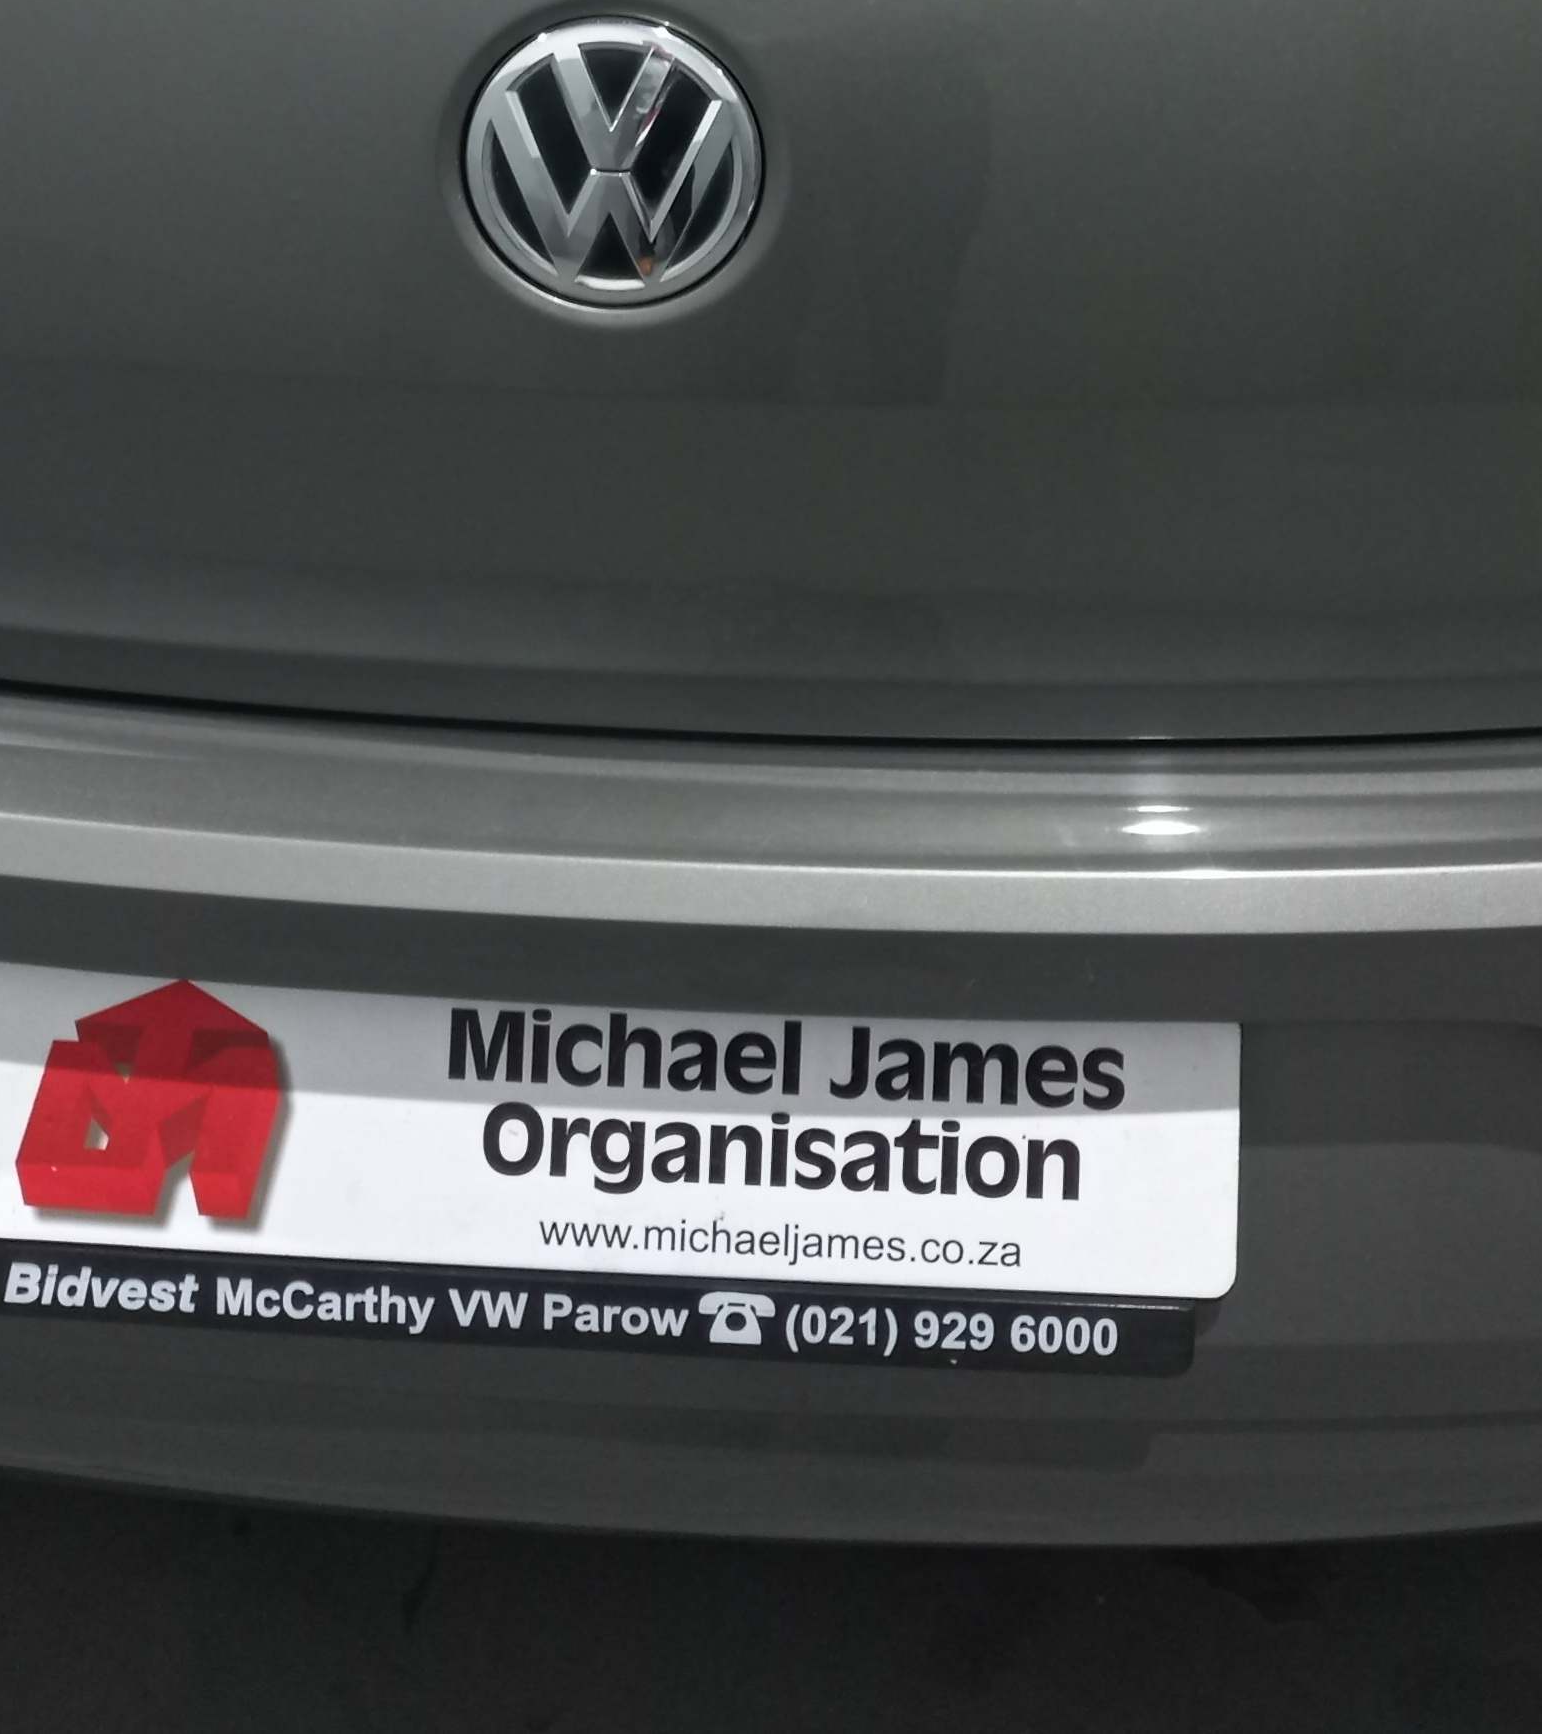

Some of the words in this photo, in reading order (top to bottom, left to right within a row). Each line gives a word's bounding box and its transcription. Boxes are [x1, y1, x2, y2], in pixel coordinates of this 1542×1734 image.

[447, 1007, 803, 1097] Michael
[829, 1025, 1127, 1111] James
[481, 1100, 1082, 1203] Organisation
[538, 1217, 1022, 1269] www.michaeljames.co.za
[3, 1261, 200, 1314] Bidvest
[215, 1277, 435, 1335] McCarthy
[448, 1288, 530, 1330] VW
[542, 1295, 689, 1338] Parow
[784, 1302, 899, 1357] (021)
[913, 1312, 996, 1352] 929
[1010, 1314, 1119, 1357] 6000
